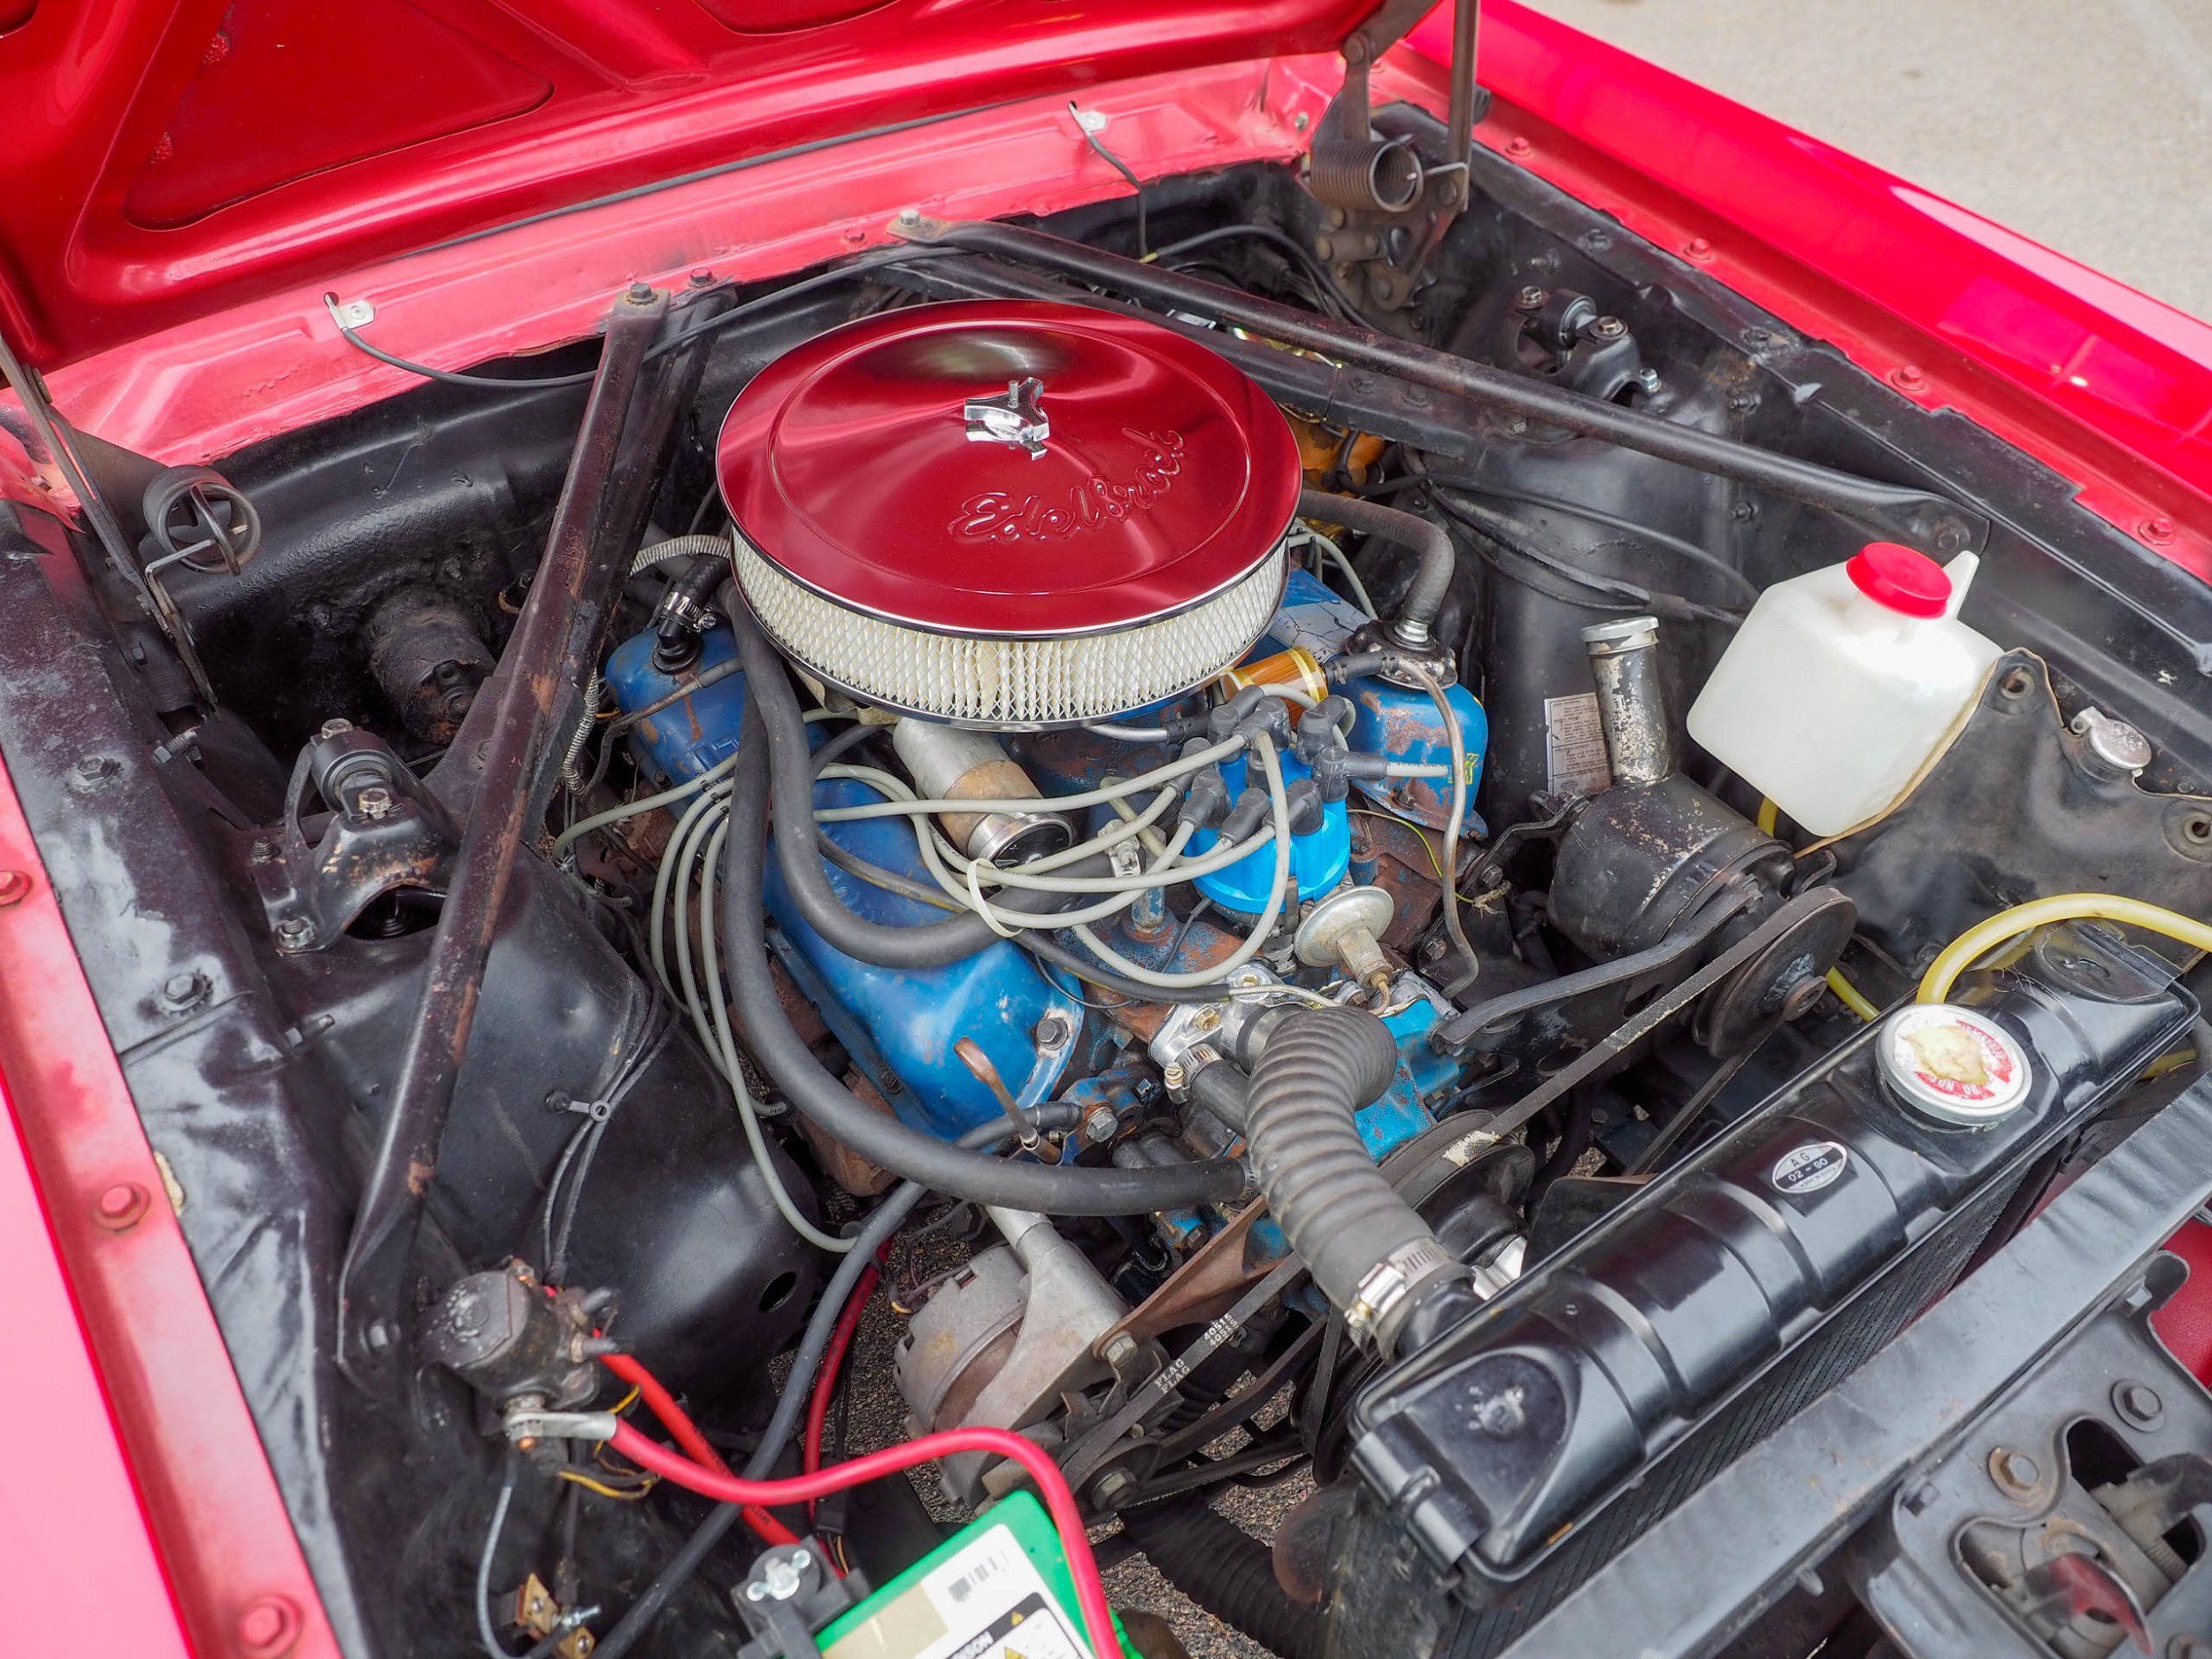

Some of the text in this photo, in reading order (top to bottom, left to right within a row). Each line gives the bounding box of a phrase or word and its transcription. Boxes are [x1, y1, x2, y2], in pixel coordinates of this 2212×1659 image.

[947, 427, 1185, 543] Edelbrock
[1154, 1357, 1185, 1387] FLAG
[1160, 1364, 1191, 1394] FLAG
